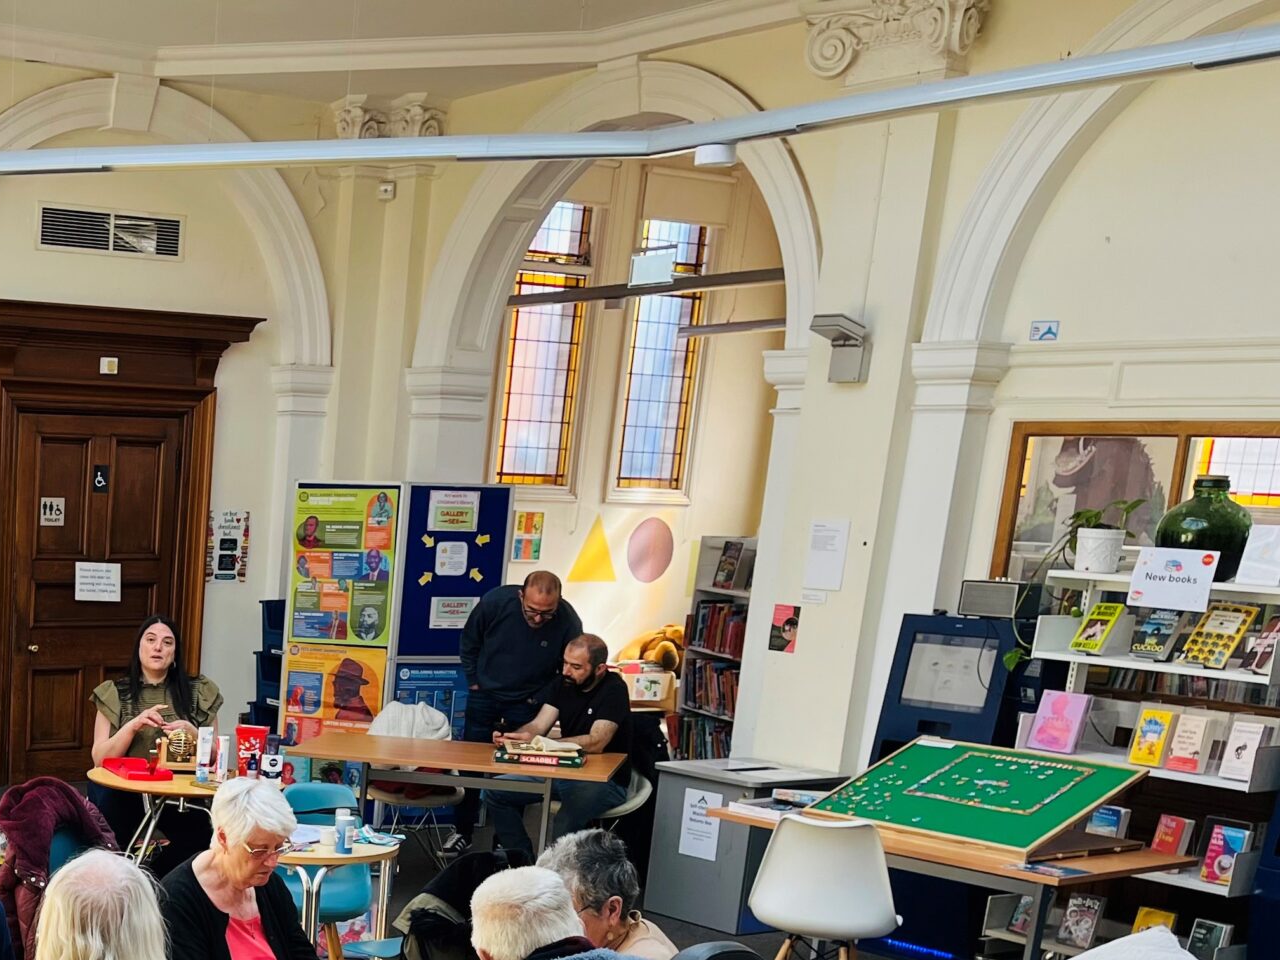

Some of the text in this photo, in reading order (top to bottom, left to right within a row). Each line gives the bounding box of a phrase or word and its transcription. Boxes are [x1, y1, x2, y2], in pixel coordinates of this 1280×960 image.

[1145, 572, 1198, 585] New books
[1132, 643, 1164, 652] CUCKOO
[521, 756, 559, 765] SCRABBLE
